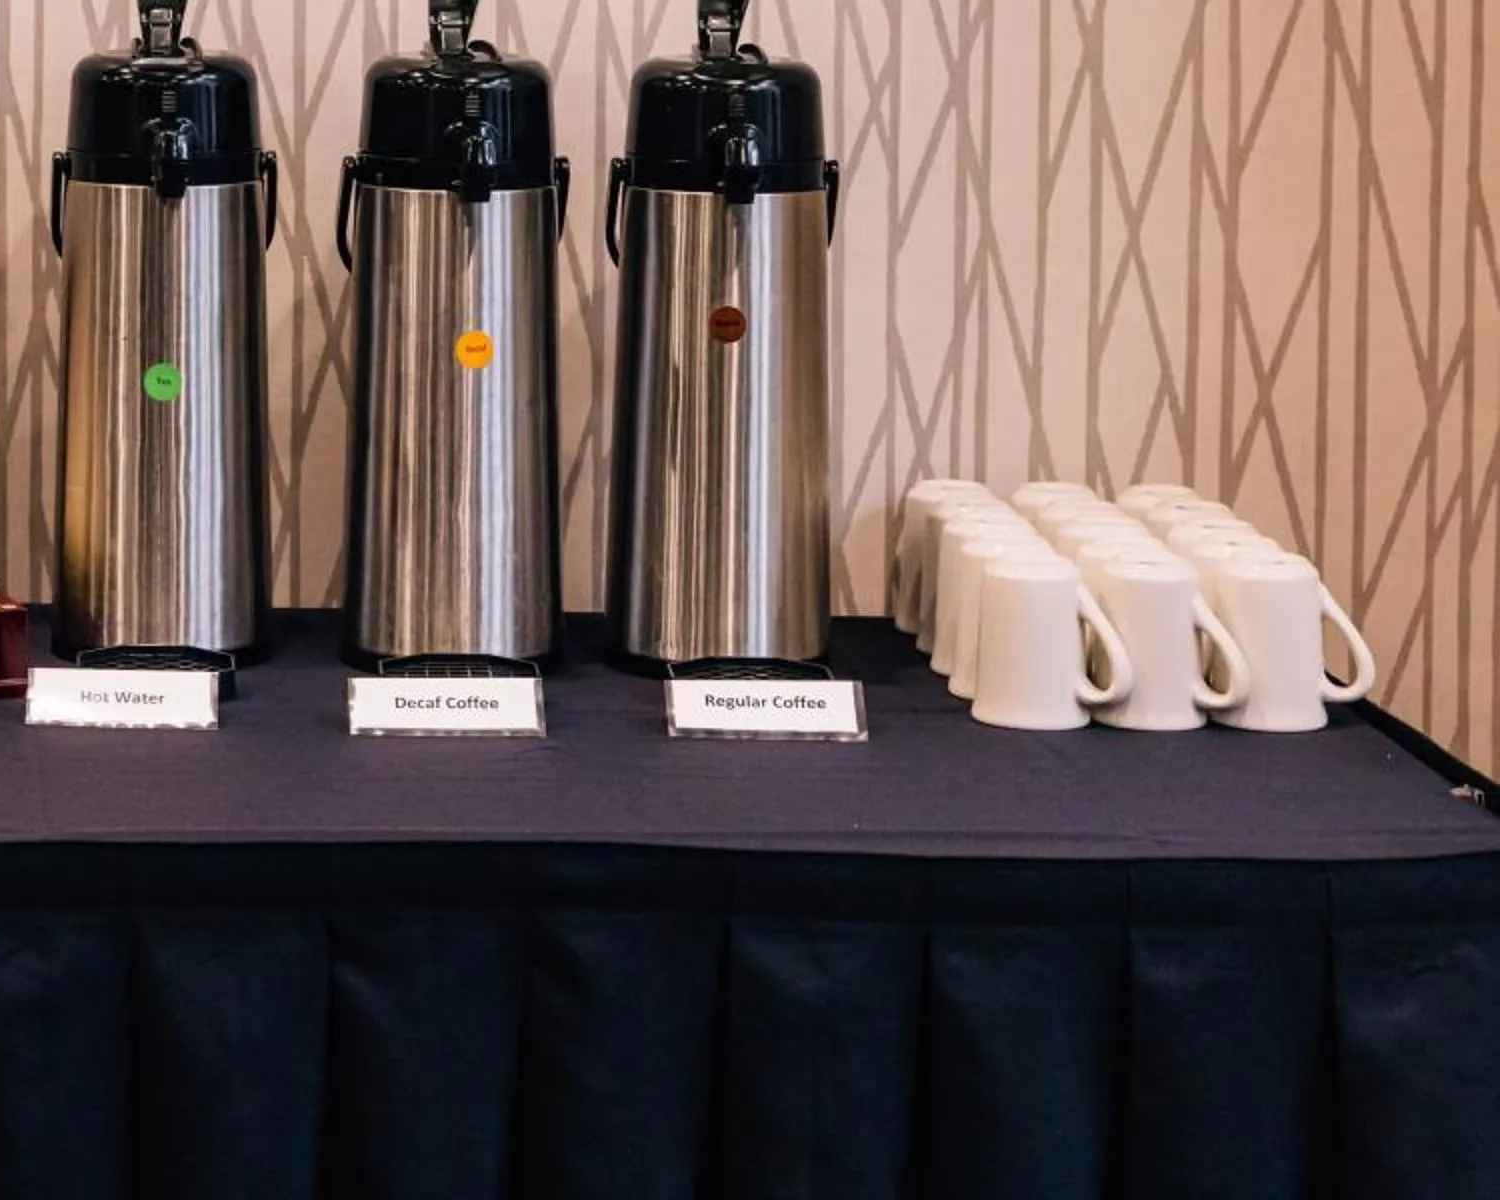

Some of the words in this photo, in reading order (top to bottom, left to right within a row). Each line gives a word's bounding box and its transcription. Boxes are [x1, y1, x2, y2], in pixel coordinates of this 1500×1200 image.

[80, 690, 109, 704] Hot
[115, 691, 165, 705] Water
[394, 696, 441, 710] Decaf
[445, 696, 499, 710] Coffee
[705, 694, 769, 710] Regular
[773, 696, 827, 709] Coffee
